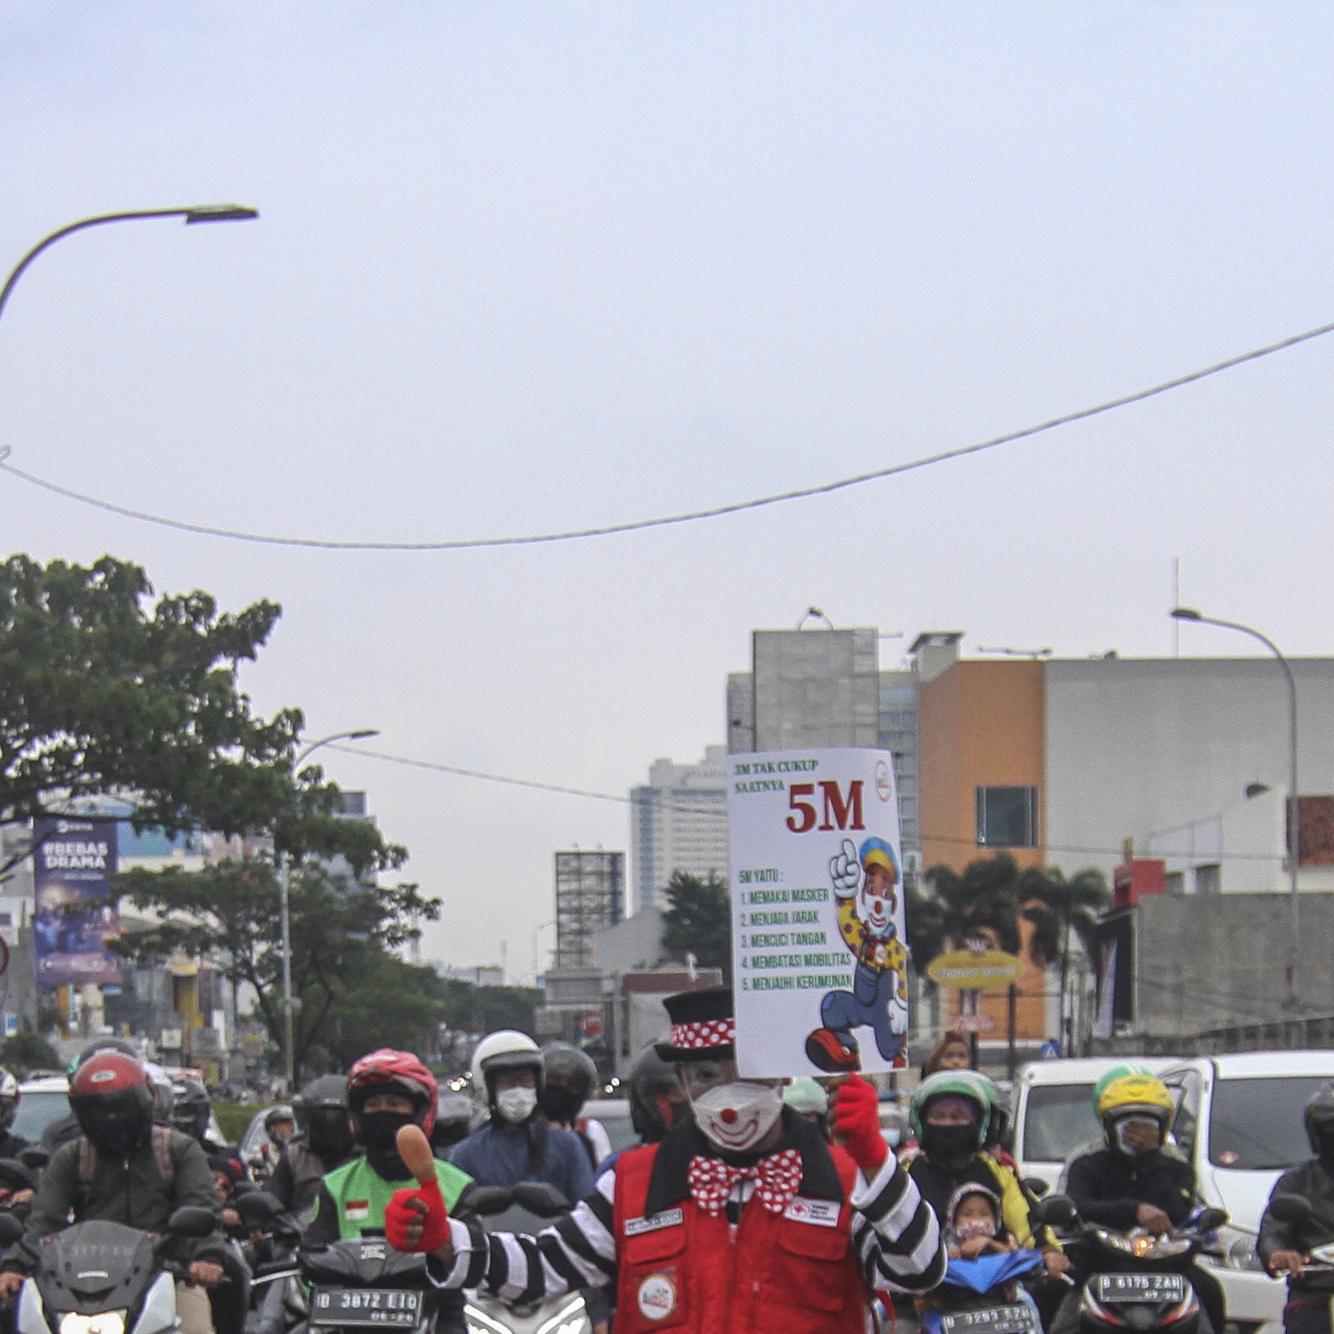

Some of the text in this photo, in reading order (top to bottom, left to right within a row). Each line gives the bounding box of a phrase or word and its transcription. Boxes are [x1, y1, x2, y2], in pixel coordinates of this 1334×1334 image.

[752, 762, 776, 774] TAK
[777, 760, 819, 773] CUKUP
[734, 780, 785, 794] SAATNYA
[786, 780, 866, 834] 5M
[45, 856, 106, 869] DRAMA
[791, 888, 830, 902] MASKER
[792, 910, 819, 924] JARAK
[790, 932, 827, 945] TANGAN
[804, 952, 852, 967] MOBILITAS
[796, 974, 853, 989] KERUMUNAN
[1103, 1276, 1110, 1289] B
[319, 1292, 330, 1308] B
[341, 1292, 380, 1309] 3872
